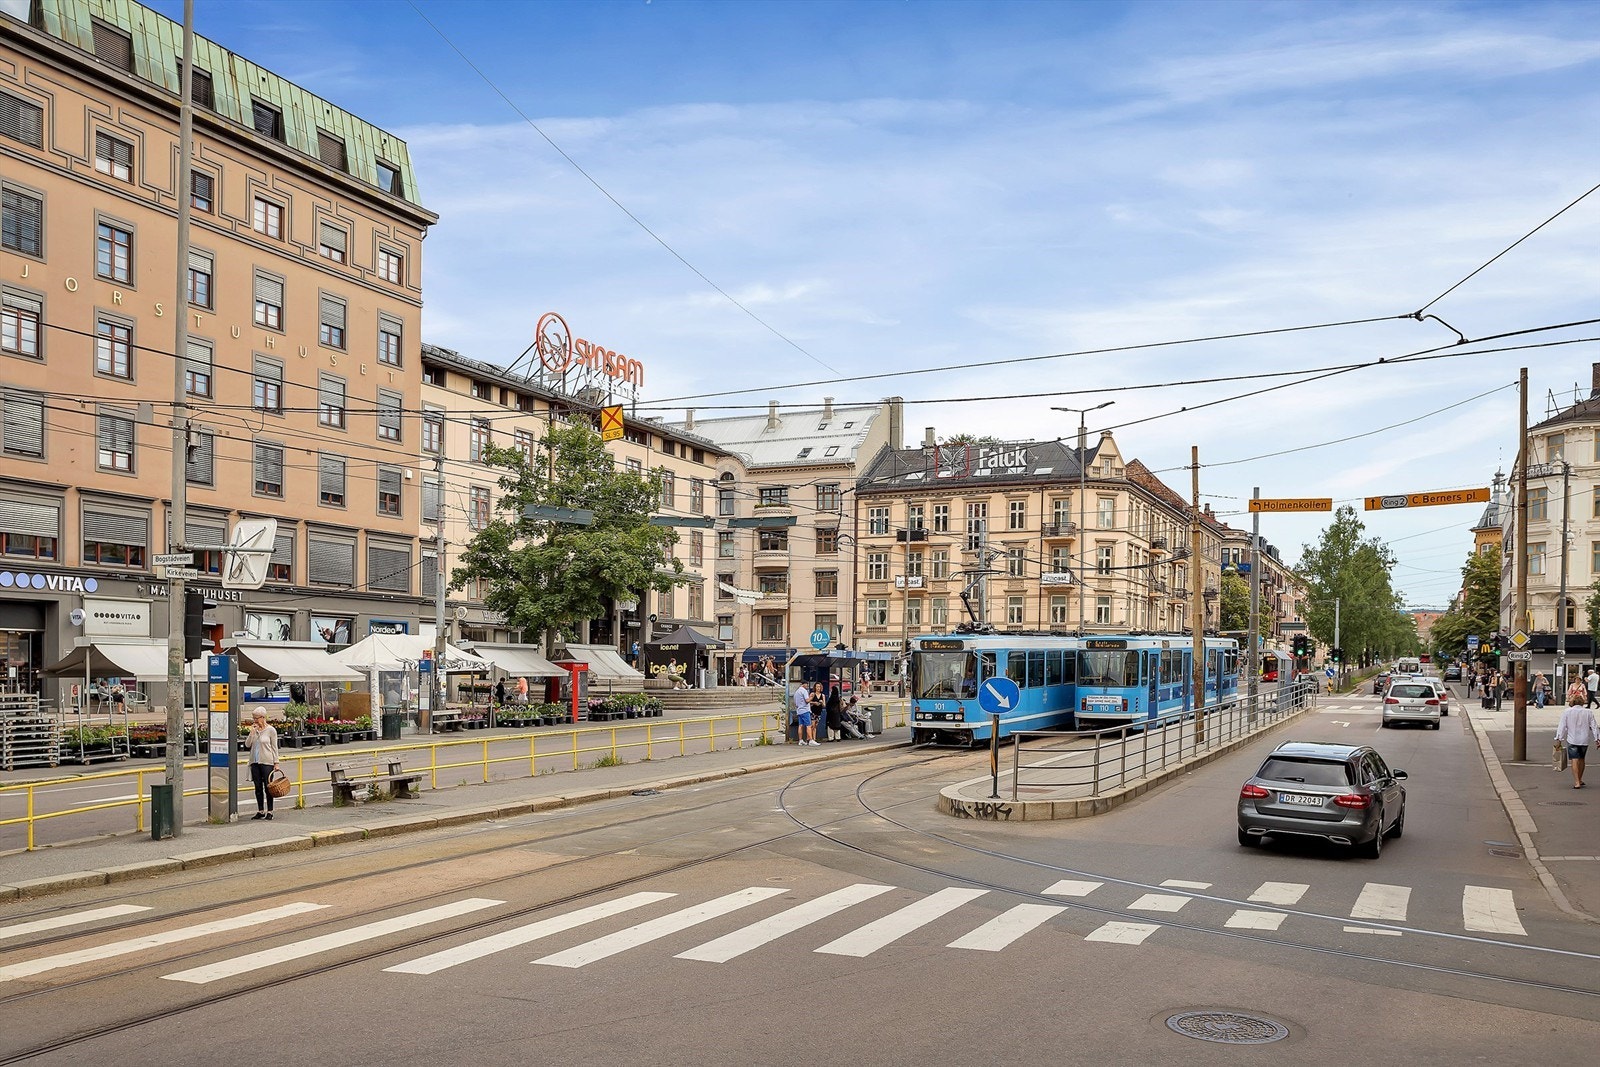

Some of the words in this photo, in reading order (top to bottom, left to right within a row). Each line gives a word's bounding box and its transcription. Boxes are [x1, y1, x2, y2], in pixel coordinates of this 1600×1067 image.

[574, 338, 643, 387] SYNSAM
[979, 446, 1027, 468] Falck
[1384, 499, 1398, 507] Ring
[1467, 492, 1477, 502] pl.
[1263, 501, 1326, 509] Holmenkollen
[155, 555, 191, 563] Bogstadveien
[167, 569, 197, 577] Kirkeveien
[46, 575, 85, 591] VITA
[370, 625, 396, 634] Nordea
[812, 632, 823, 642] 10
[934, 702, 945, 711] 101
[1285, 794, 1296, 802] DR
[1299, 796, 1321, 805] 22043
